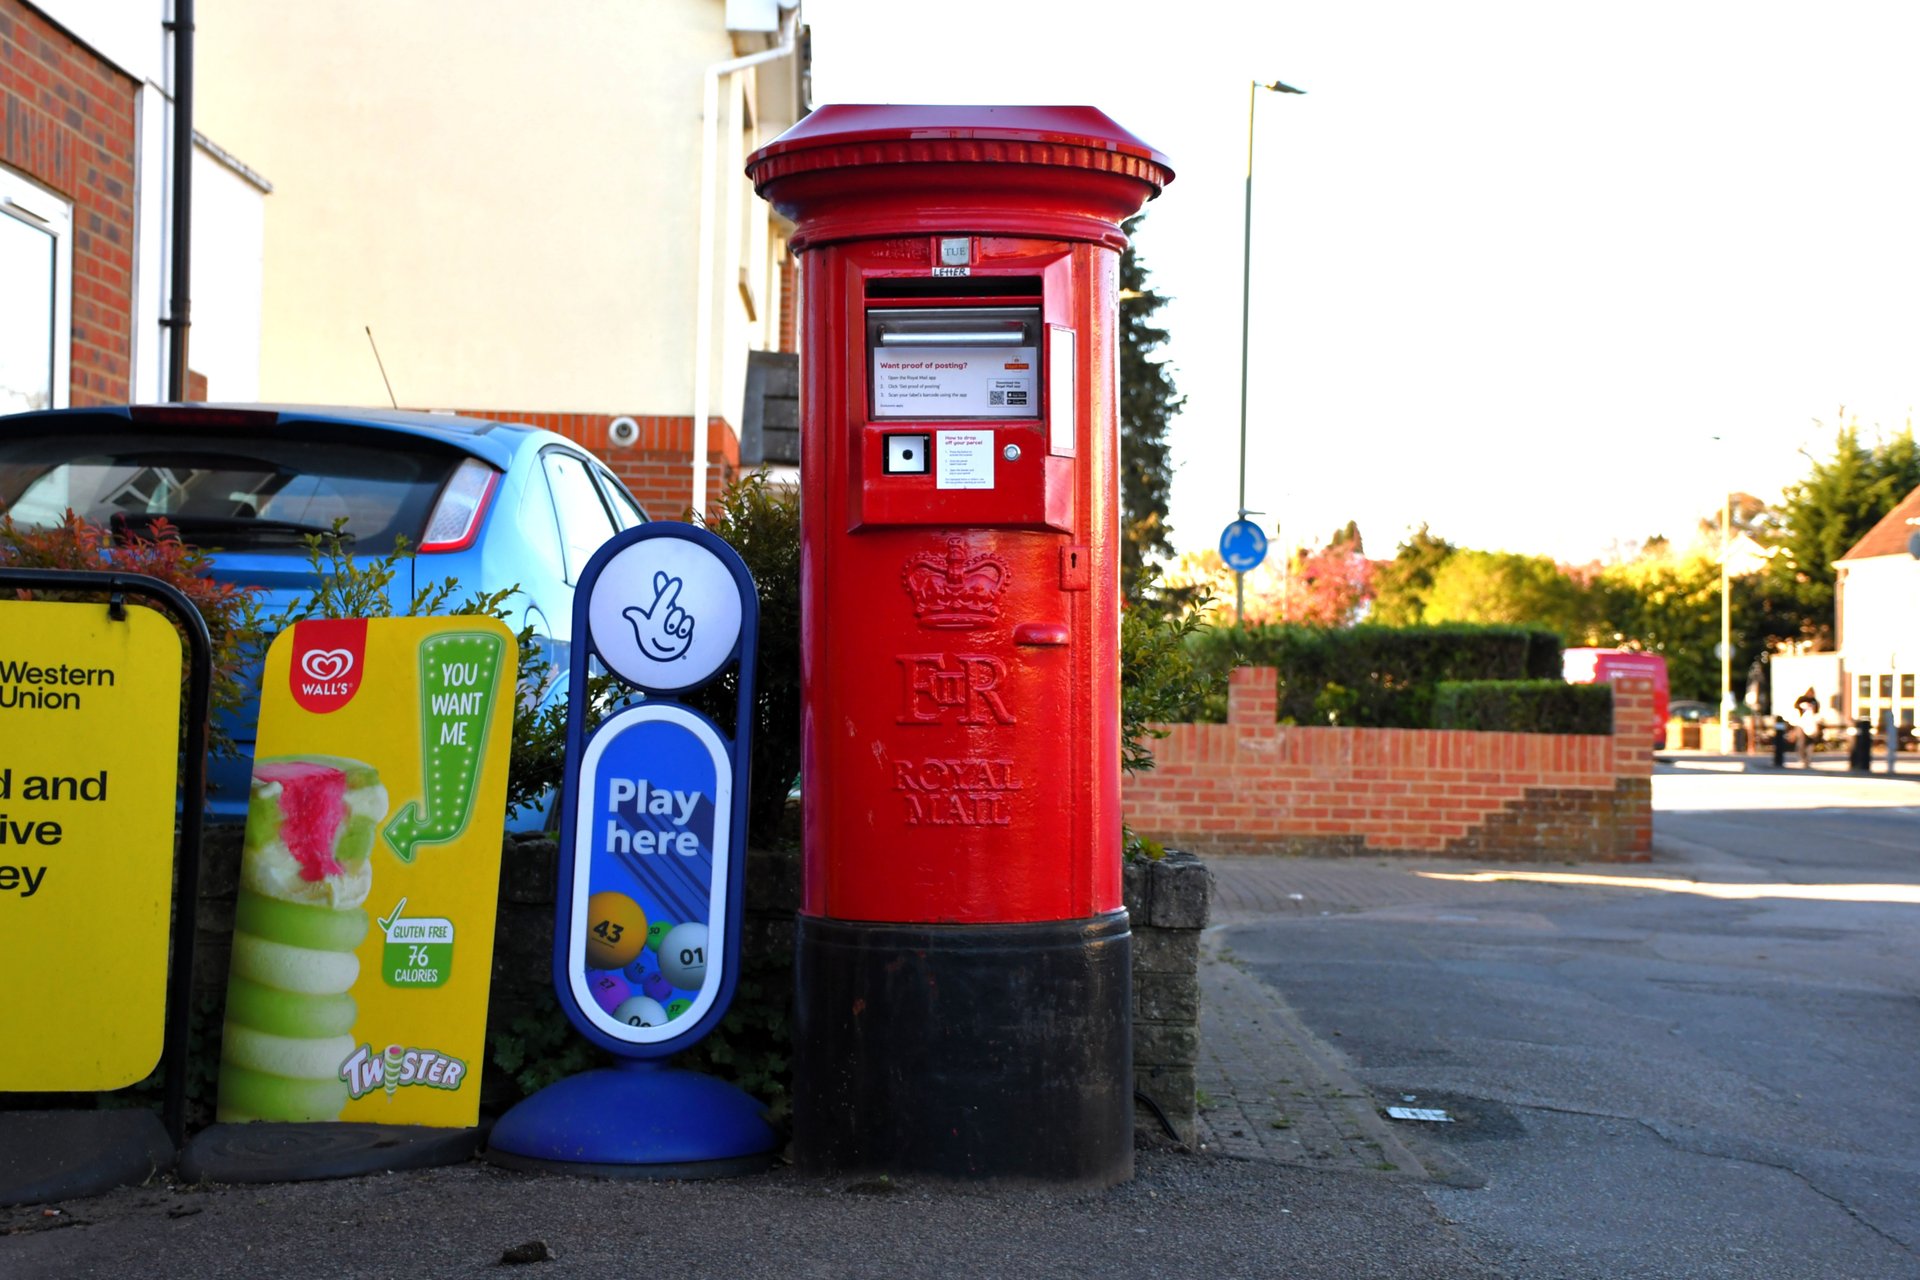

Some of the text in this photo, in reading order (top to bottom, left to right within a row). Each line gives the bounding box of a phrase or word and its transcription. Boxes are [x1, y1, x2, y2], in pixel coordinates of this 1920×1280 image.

[944, 247, 966, 256] TUE
[901, 362, 923, 370] proof
[934, 362, 968, 370] posting?
[0, 660, 115, 686] Western
[442, 662, 479, 687] YOU
[0, 685, 80, 710] Union
[301, 682, 349, 696] WALL'S
[431, 691, 484, 716] WANT
[440, 721, 468, 746] ME
[22, 770, 107, 802] and
[893, 757, 1024, 791] ROYAL
[608, 777, 702, 826] Play
[904, 793, 1012, 826] MAIL
[0, 813, 63, 846] ive
[606, 819, 700, 857] here
[0, 865, 48, 898] ey
[393, 925, 449, 939] GLUTEN FREE
[593, 920, 624, 943] 43
[408, 945, 429, 967] 76
[680, 947, 704, 966] 01
[394, 968, 438, 983] CALORIES
[600, 978, 616, 989] 27
